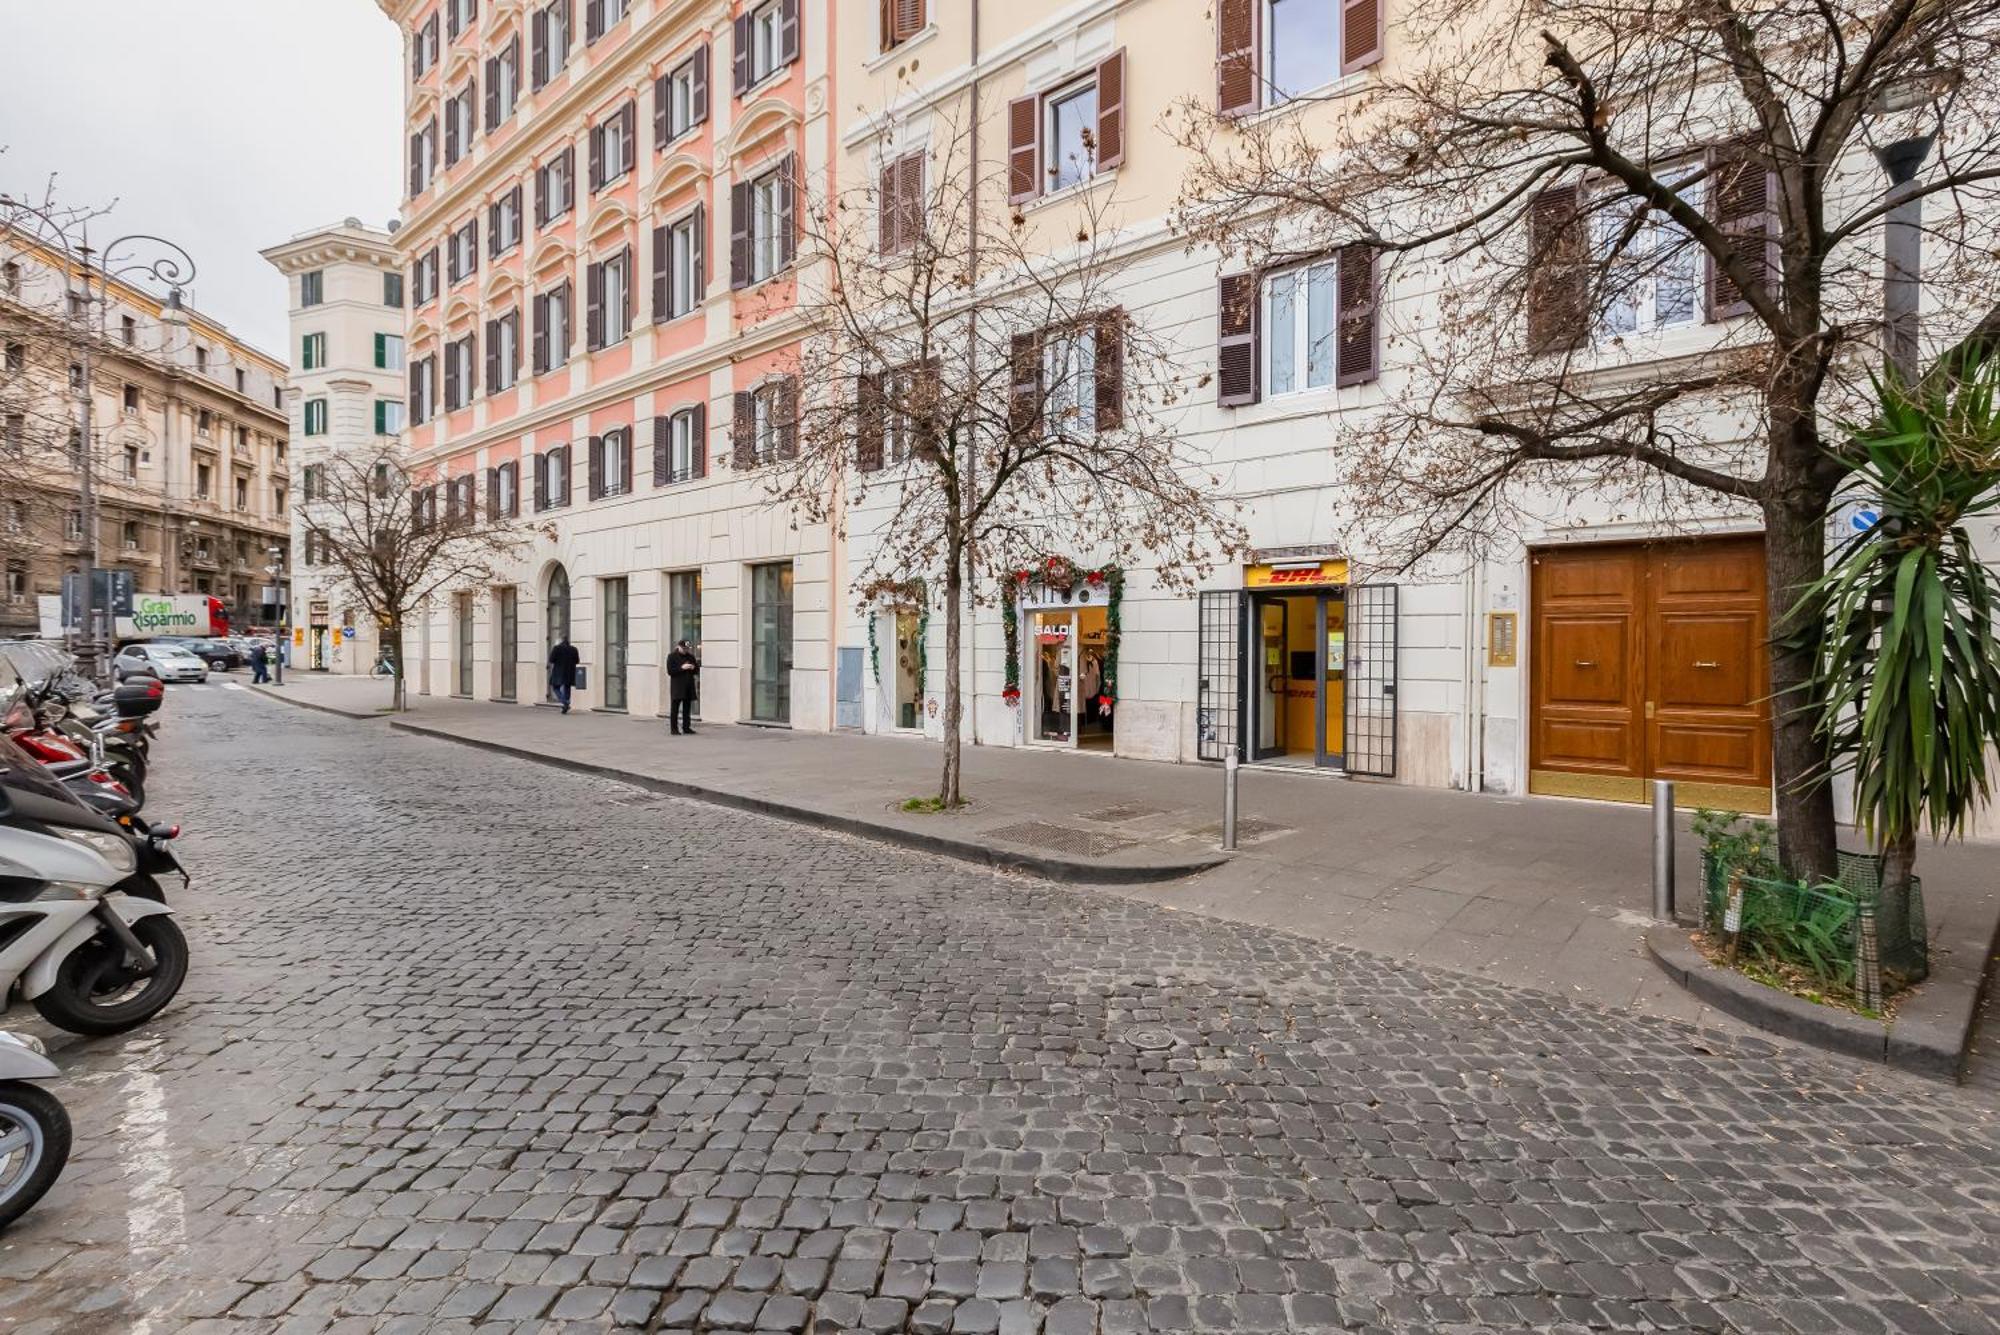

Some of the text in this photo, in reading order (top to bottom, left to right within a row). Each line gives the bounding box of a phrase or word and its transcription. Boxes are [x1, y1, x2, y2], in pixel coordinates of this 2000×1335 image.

[1269, 567, 1324, 583] DHL
[142, 598, 172, 613] Gran
[132, 610, 196, 631] Risparmio
